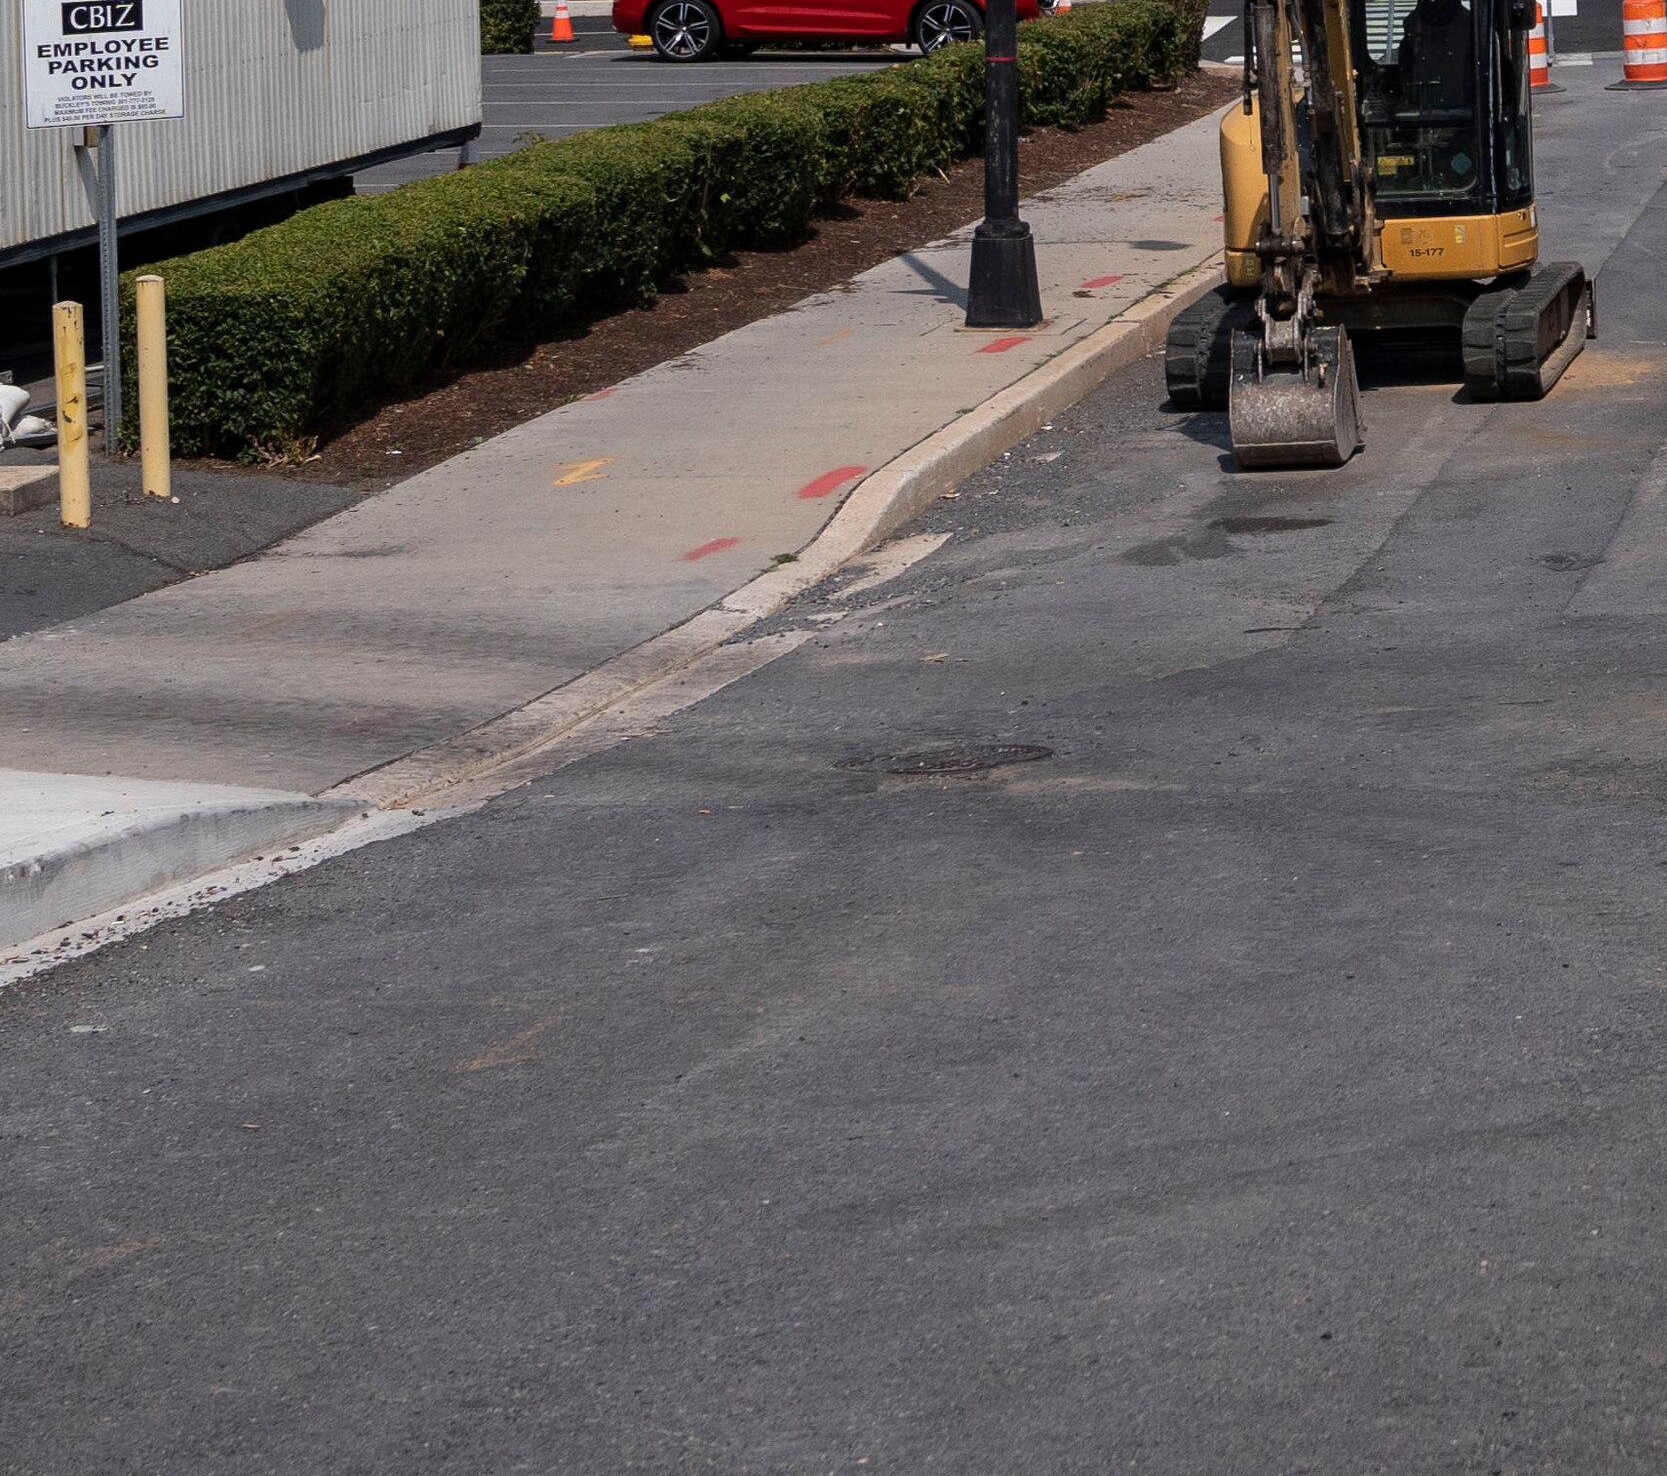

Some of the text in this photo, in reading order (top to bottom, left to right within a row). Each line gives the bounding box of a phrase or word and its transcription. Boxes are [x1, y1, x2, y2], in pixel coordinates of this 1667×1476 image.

[70, 3, 135, 30] CBIZ
[37, 37, 169, 58] EMPLOYEE
[48, 54, 159, 75] PARKING
[71, 72, 137, 90] ONLY
[1409, 248, 1444, 257] 15-177
